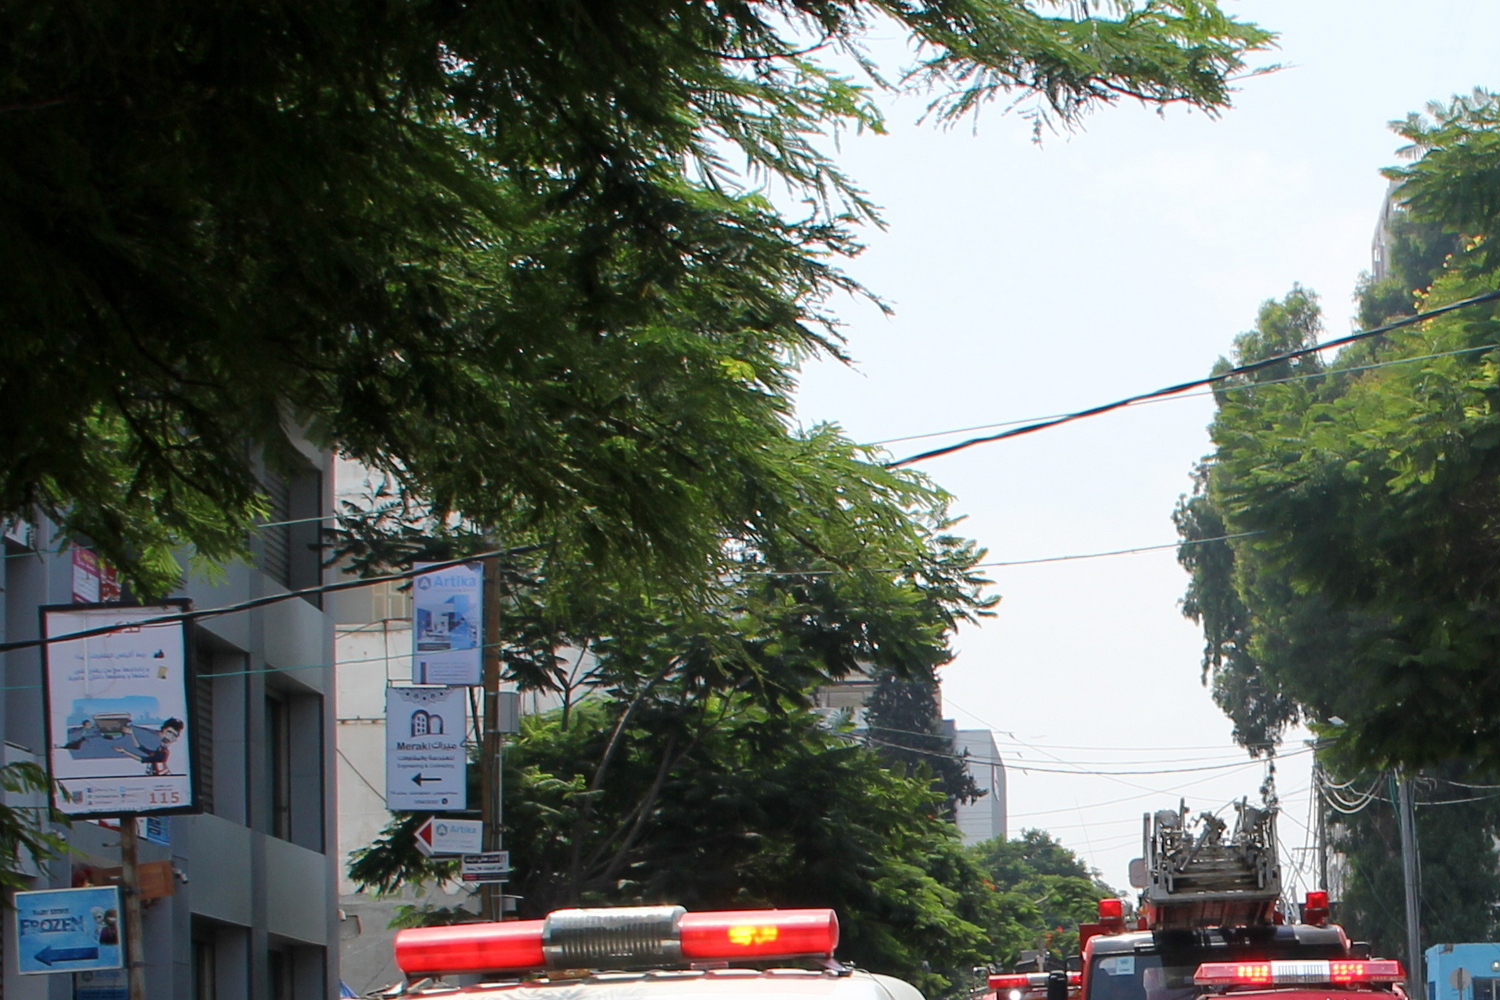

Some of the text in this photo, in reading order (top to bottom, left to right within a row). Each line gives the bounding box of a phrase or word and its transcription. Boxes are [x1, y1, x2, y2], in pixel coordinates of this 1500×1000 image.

[433, 576, 476, 587] Artika
[149, 792, 180, 804] 115
[450, 825, 477, 834] Artika
[20, 916, 85, 936] FROZEN
